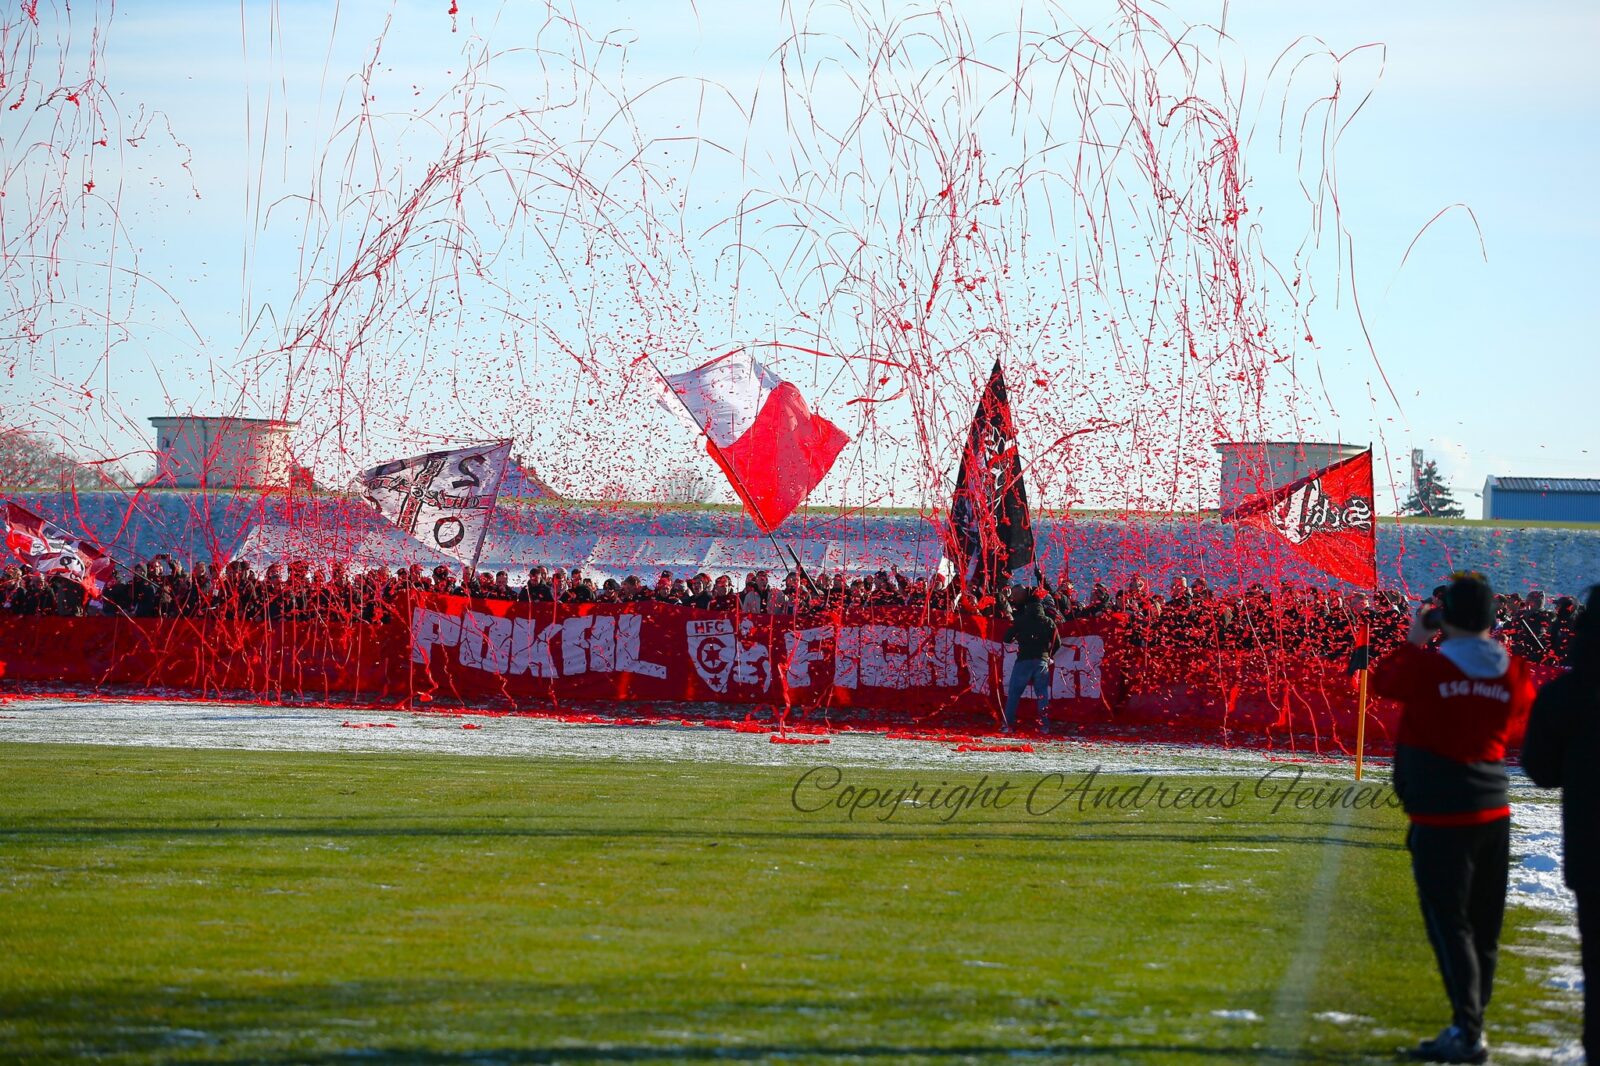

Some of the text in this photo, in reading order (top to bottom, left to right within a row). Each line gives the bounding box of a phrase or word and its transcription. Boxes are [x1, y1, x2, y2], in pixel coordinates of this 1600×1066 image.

[694, 621, 724, 634] HFC
[412, 606, 667, 680] POKAL
[1438, 680, 1510, 703] ESG Halle
